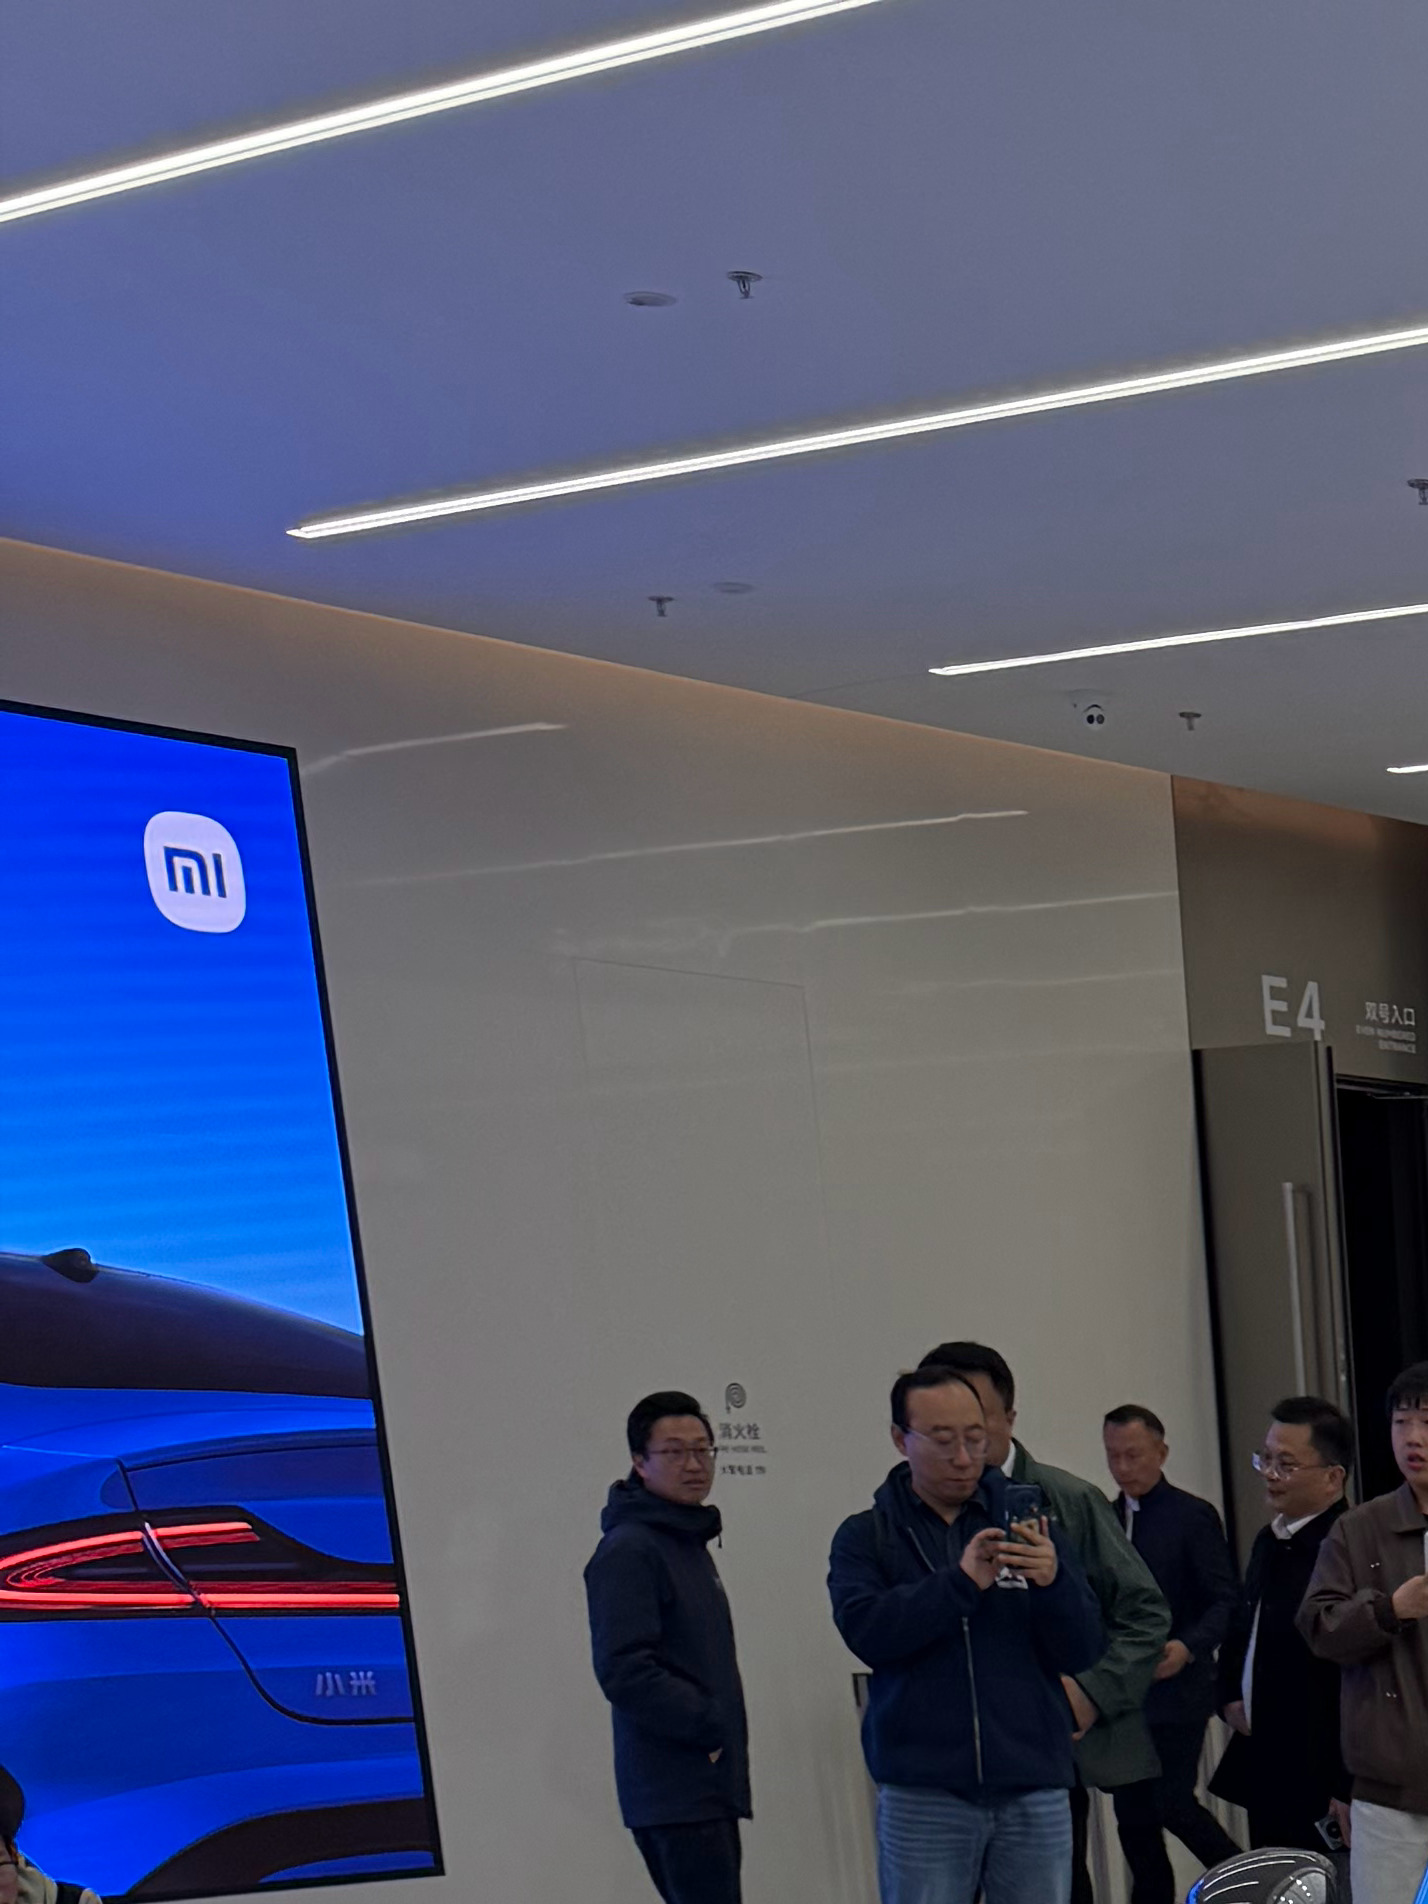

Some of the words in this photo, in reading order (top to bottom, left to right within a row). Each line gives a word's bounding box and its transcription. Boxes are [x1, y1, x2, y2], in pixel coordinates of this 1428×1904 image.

[1261, 974, 1326, 1041] E4
[1365, 1001, 1415, 1026] 双号入口
